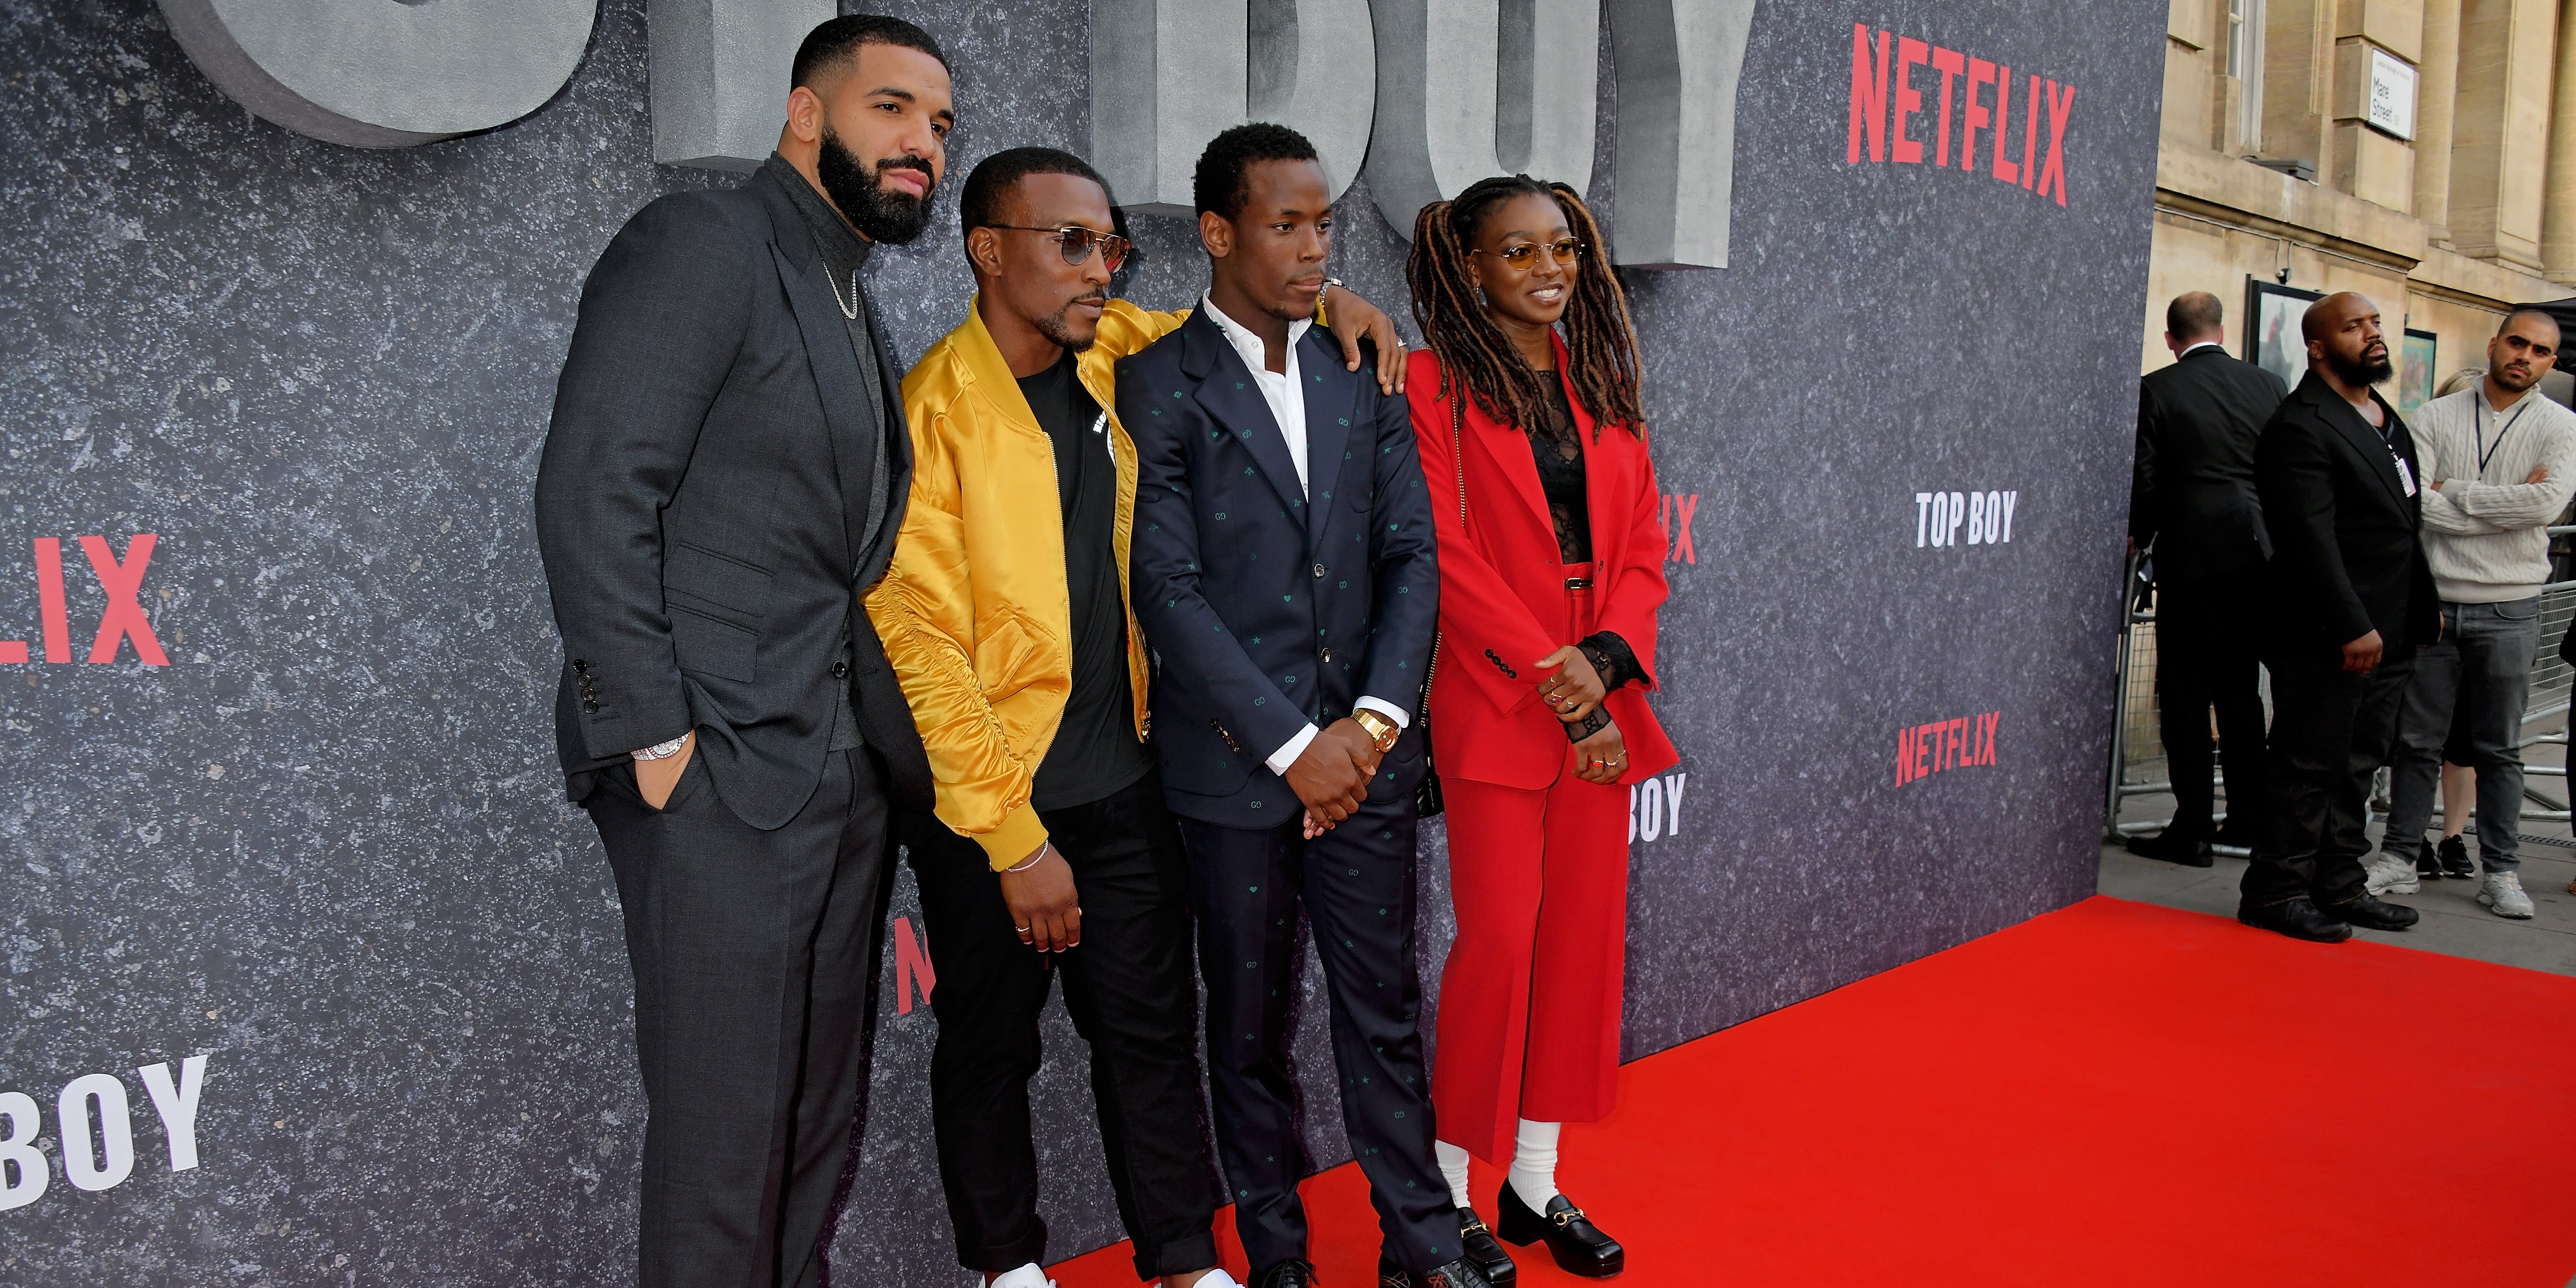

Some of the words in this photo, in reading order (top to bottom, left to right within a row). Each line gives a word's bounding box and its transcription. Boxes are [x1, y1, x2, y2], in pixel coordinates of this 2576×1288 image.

[1848, 23, 2075, 207] NETFLIX
[2372, 98, 2392, 123] Street
[2373, 76, 2388, 99] Mare
[1916, 491, 1965, 548] TOP
[1967, 490, 2018, 545] BOY
[1896, 710, 2001, 788] NETFLIX
[0, 1054, 208, 1211] BOY
